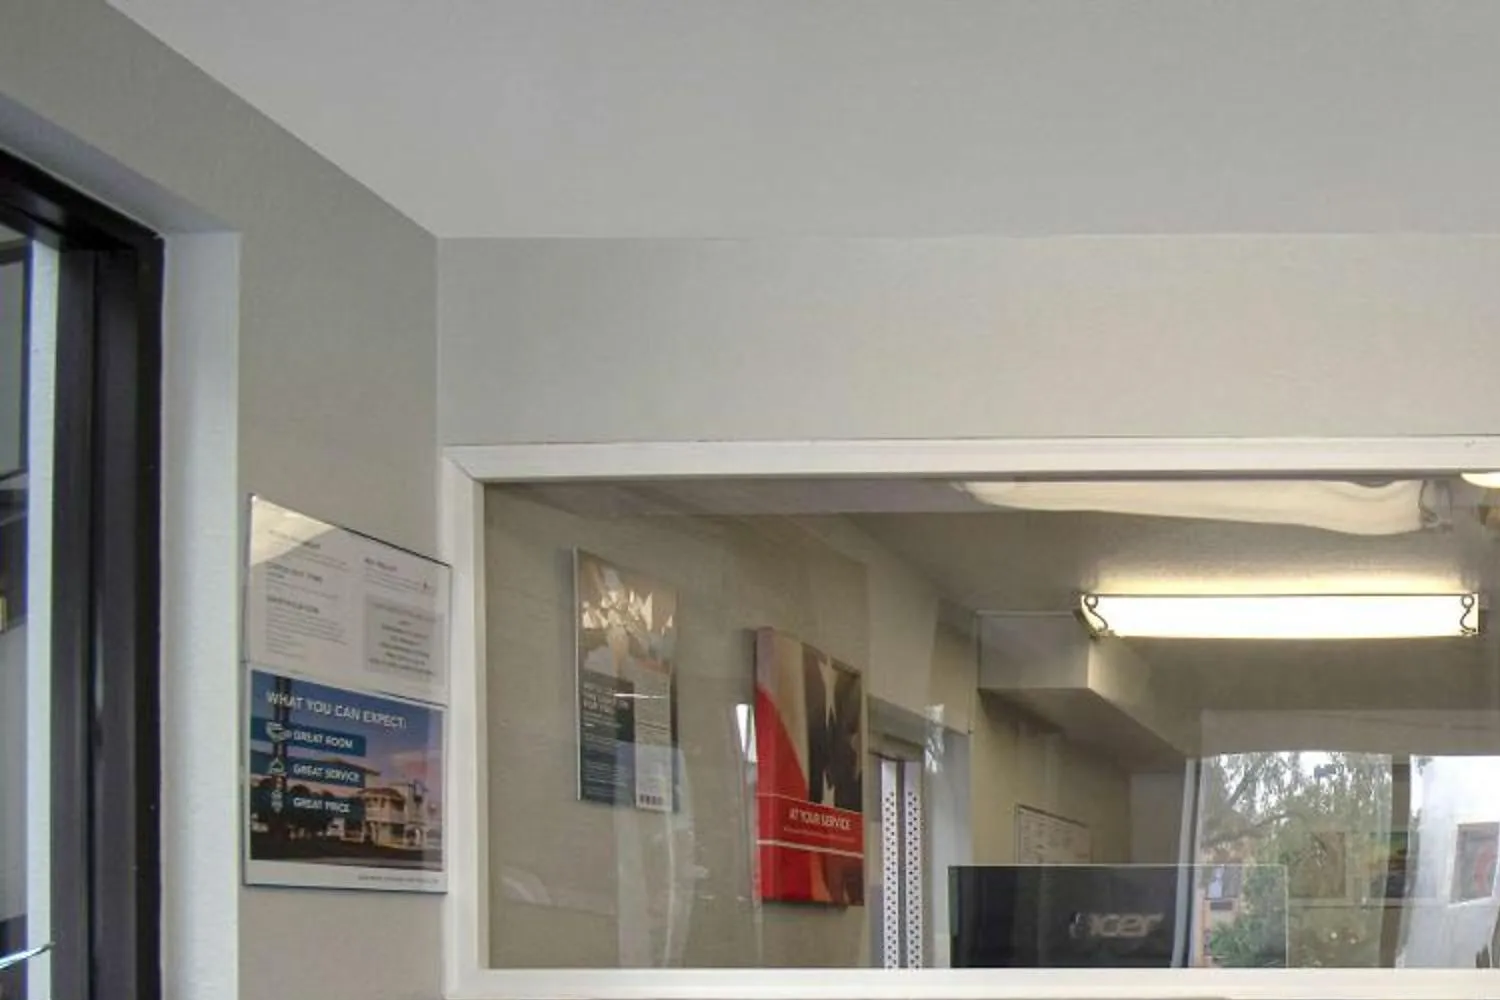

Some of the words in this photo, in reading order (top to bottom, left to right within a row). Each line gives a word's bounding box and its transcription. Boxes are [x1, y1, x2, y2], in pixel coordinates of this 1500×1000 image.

[266, 690, 303, 707] WHAT
[307, 698, 332, 715] YOU
[334, 705, 361, 722] CAN
[293, 731, 324, 745] GREAT
[325, 735, 354, 749] ROOM
[293, 763, 324, 777] GREAT
[325, 767, 361, 783] SERVICE
[293, 797, 323, 809] GREAT
